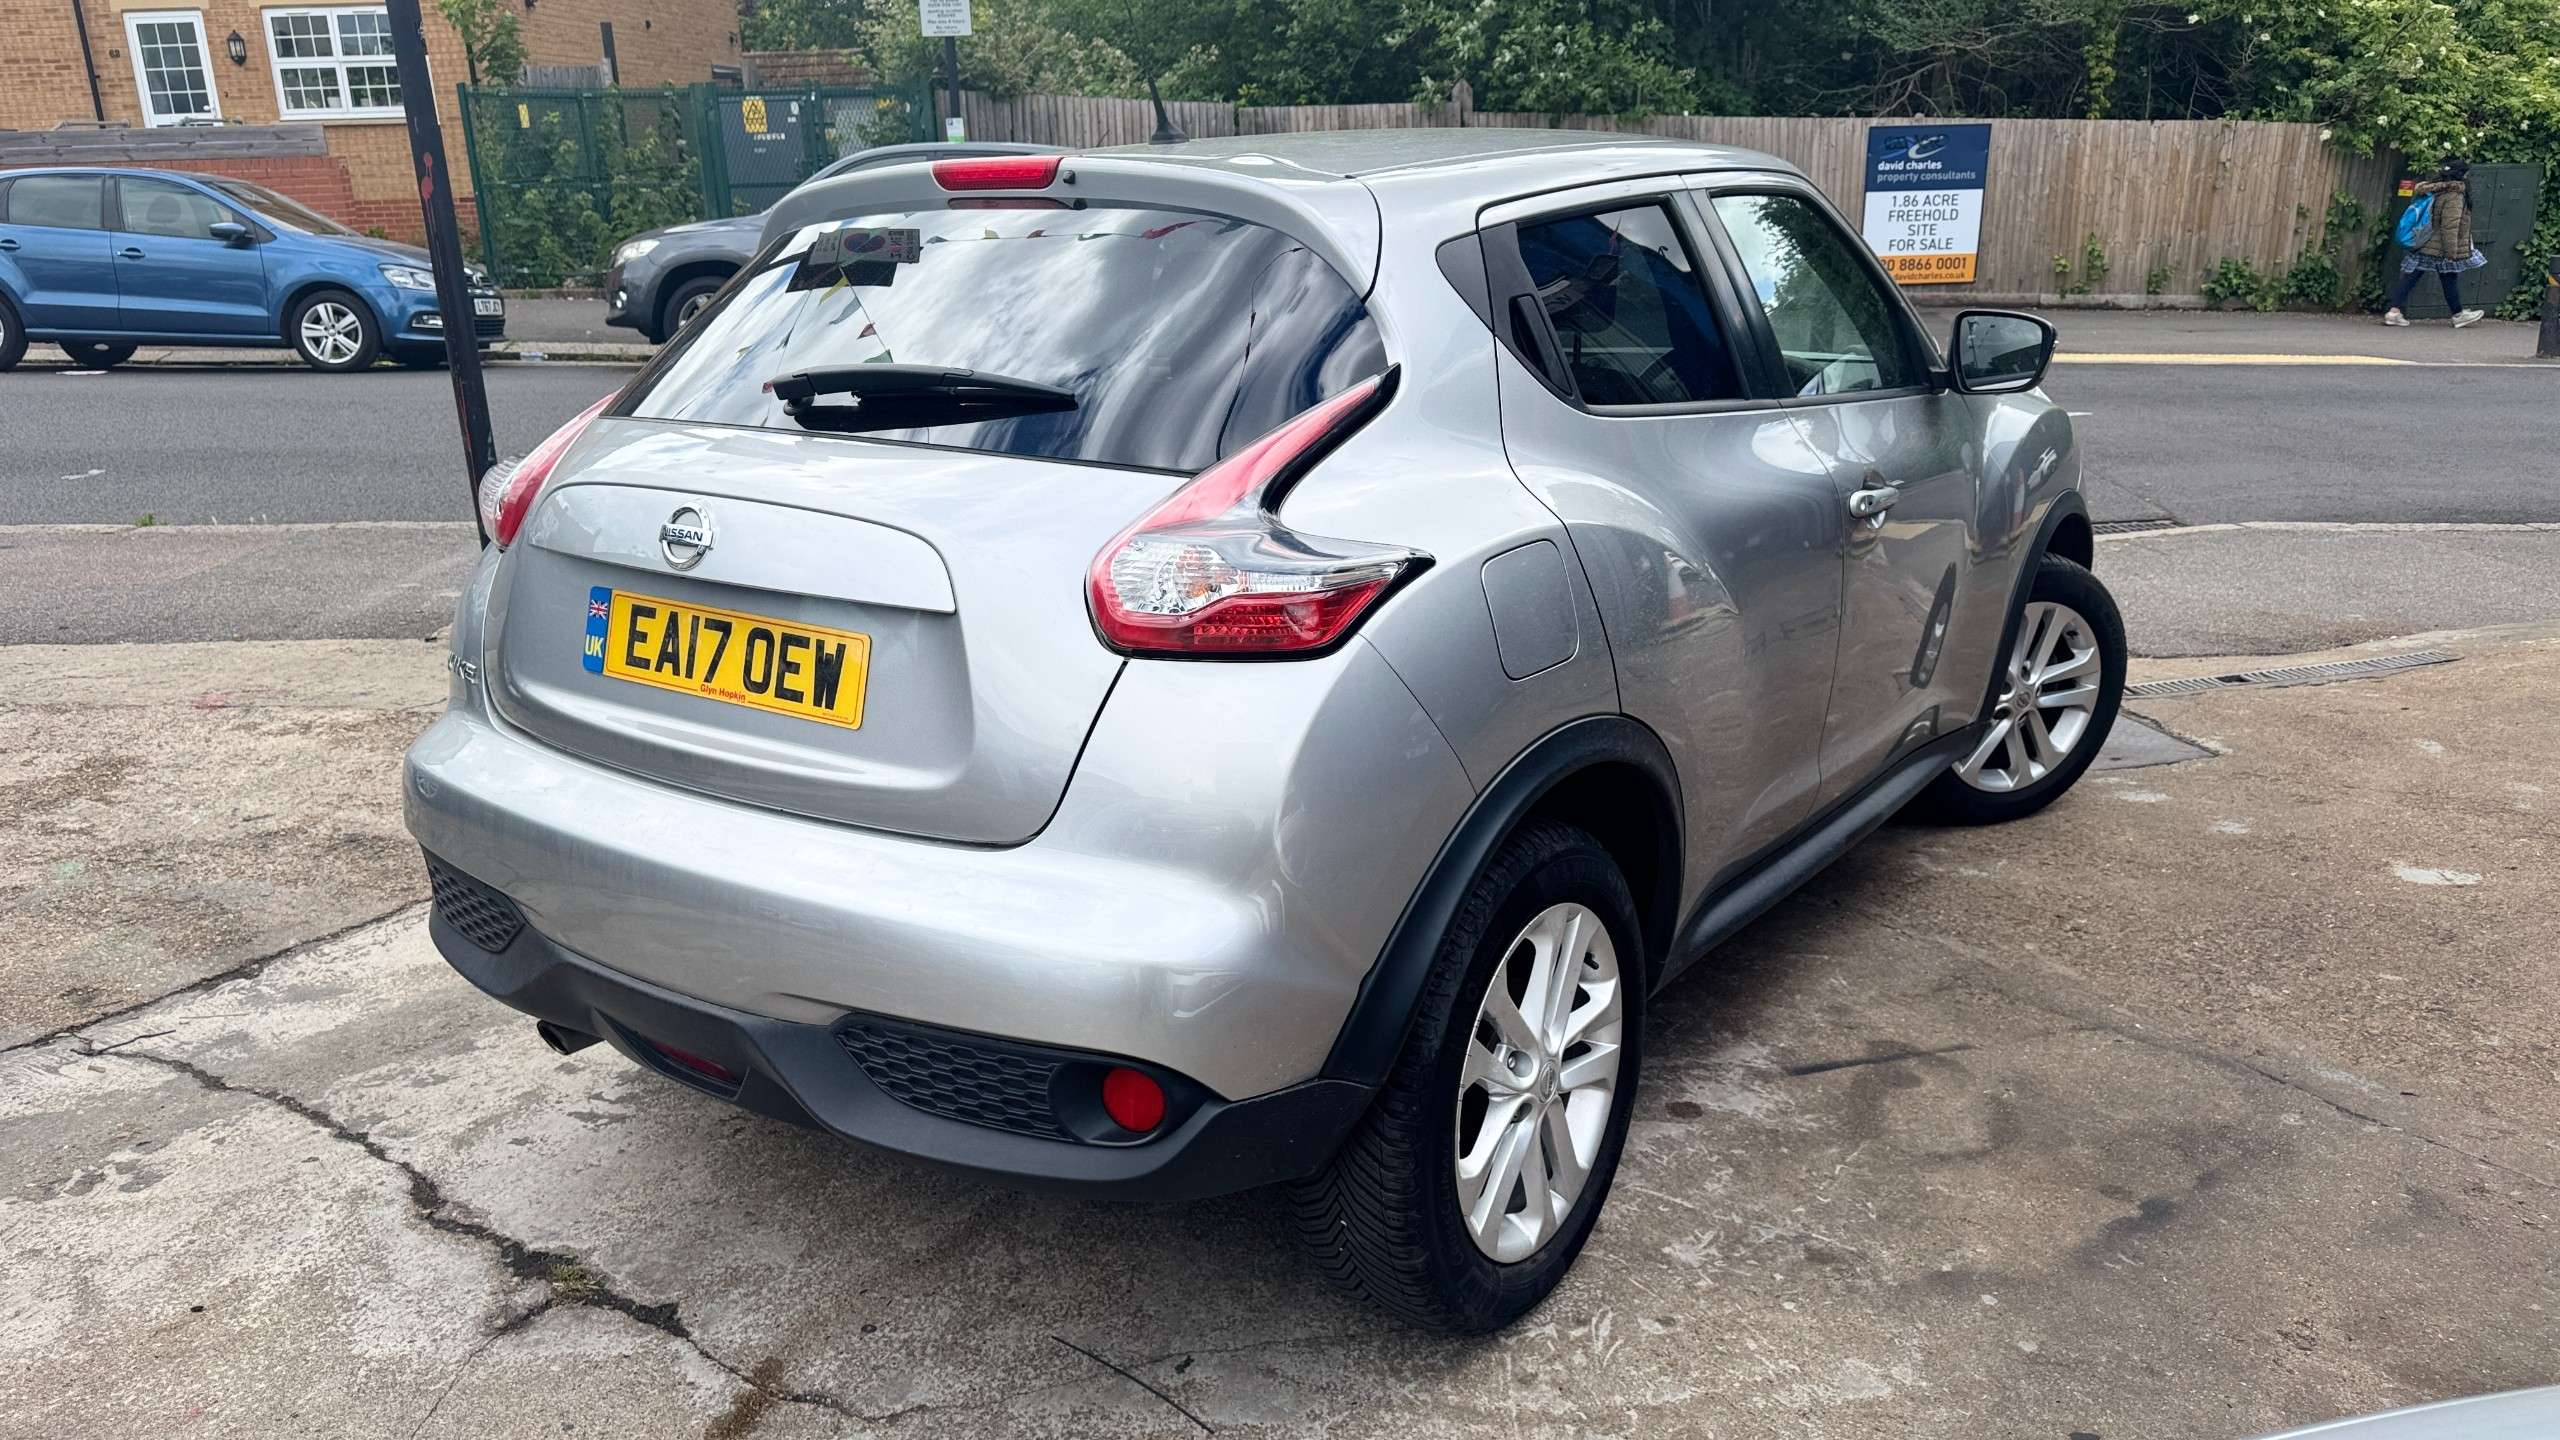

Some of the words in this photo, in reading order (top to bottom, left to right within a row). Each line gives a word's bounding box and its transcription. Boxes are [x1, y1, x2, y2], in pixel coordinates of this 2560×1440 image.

[1878, 160, 1904, 171] david
[1906, 160, 1942, 170] charles
[1877, 172, 1919, 184] property
[1920, 171, 1976, 181] consultants
[1892, 194, 1919, 208] 1.86
[1922, 193, 1959, 207] ACRE
[1888, 208, 1959, 222] FREEHOLD
[1907, 224, 1938, 236] SITE
[1888, 239, 1916, 252] FOR
[1920, 238, 1953, 250] SALE
[1900, 258, 1932, 271] 8866
[1936, 257, 1967, 270] 0001
[664, 526, 704, 542] NISSAN
[584, 634, 604, 658] UK
[625, 604, 733, 684] EA17
[742, 627, 847, 711] OEW
[700, 683, 717, 696] Glyn
[719, 685, 746, 702] Hopkin
